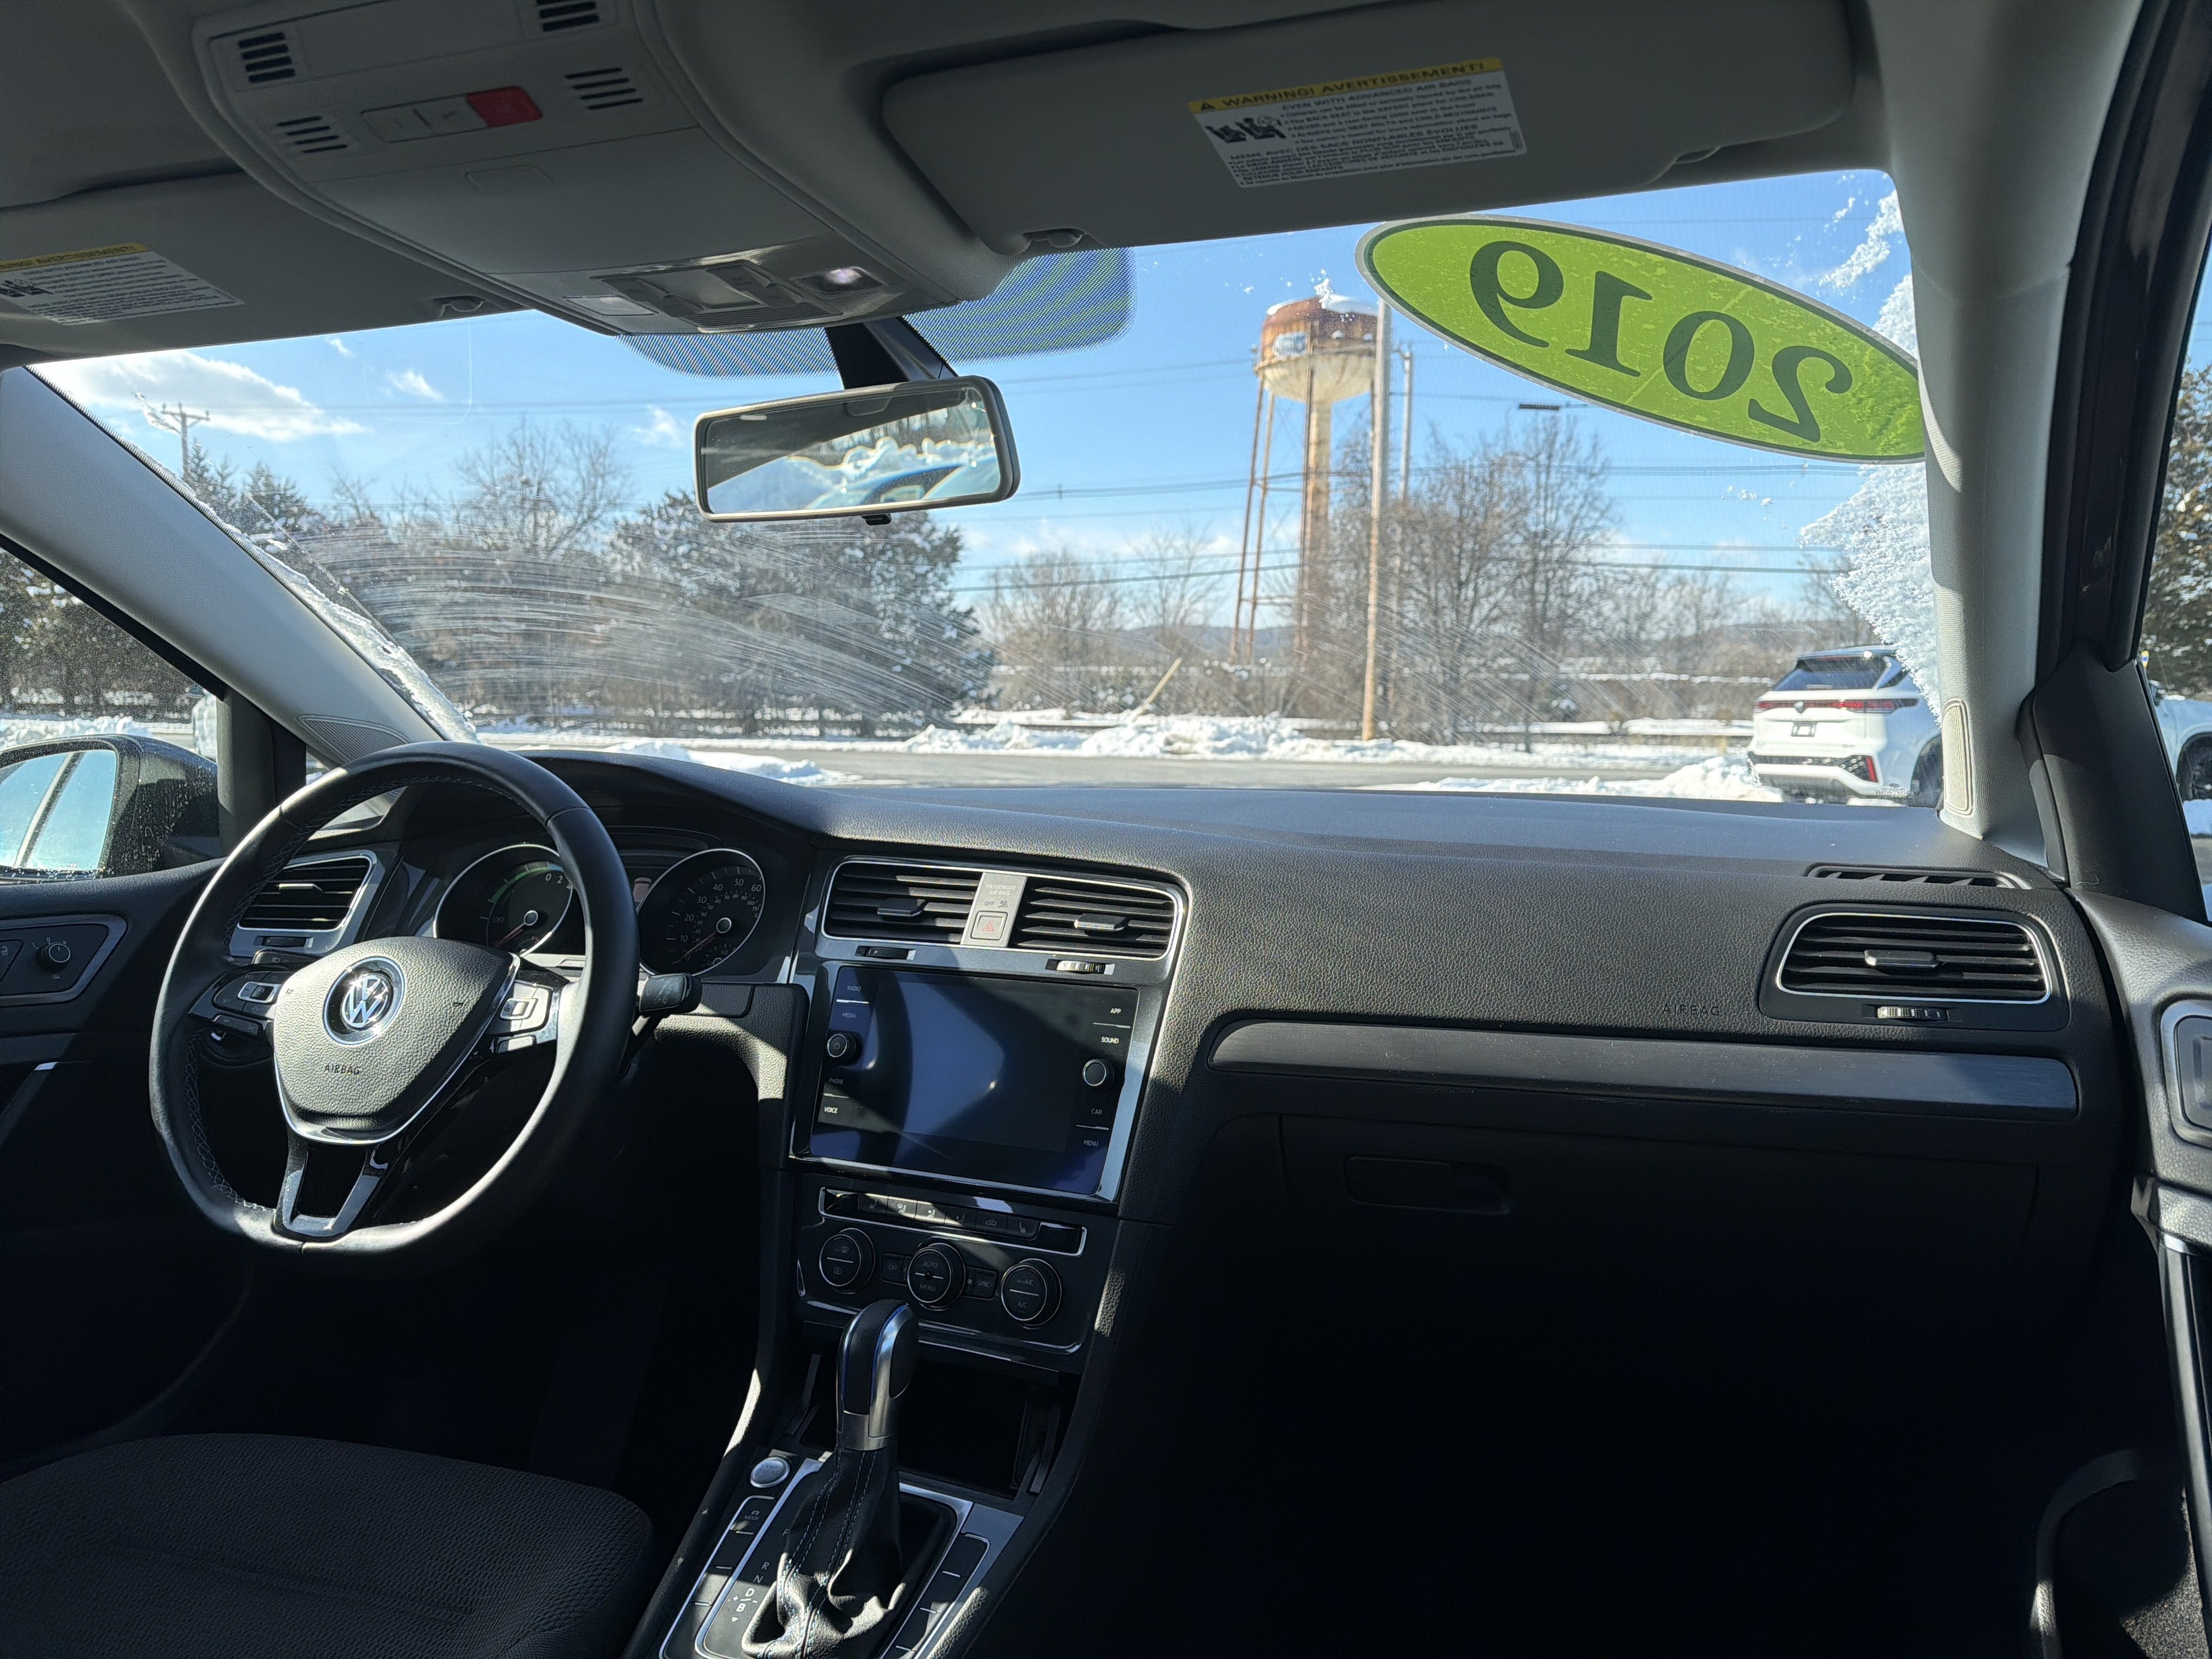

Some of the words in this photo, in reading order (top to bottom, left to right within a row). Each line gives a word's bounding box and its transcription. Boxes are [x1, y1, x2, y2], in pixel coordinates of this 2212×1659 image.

[1222, 87, 1315, 106] WARNING!
[1319, 62, 1485, 93] AVERTISSEMENT!
[1662, 1004, 1720, 1016] AIRBAG
[324, 1065, 361, 1076] AIRBAG
[920, 1283, 936, 1291] MENU
[978, 1278, 989, 1288] SYNC
[1017, 1301, 1028, 1309] A/C
[761, 1561, 770, 1570] R
[752, 1575, 764, 1584] N
[744, 1588, 755, 1597] D
[736, 1602, 746, 1612] B
